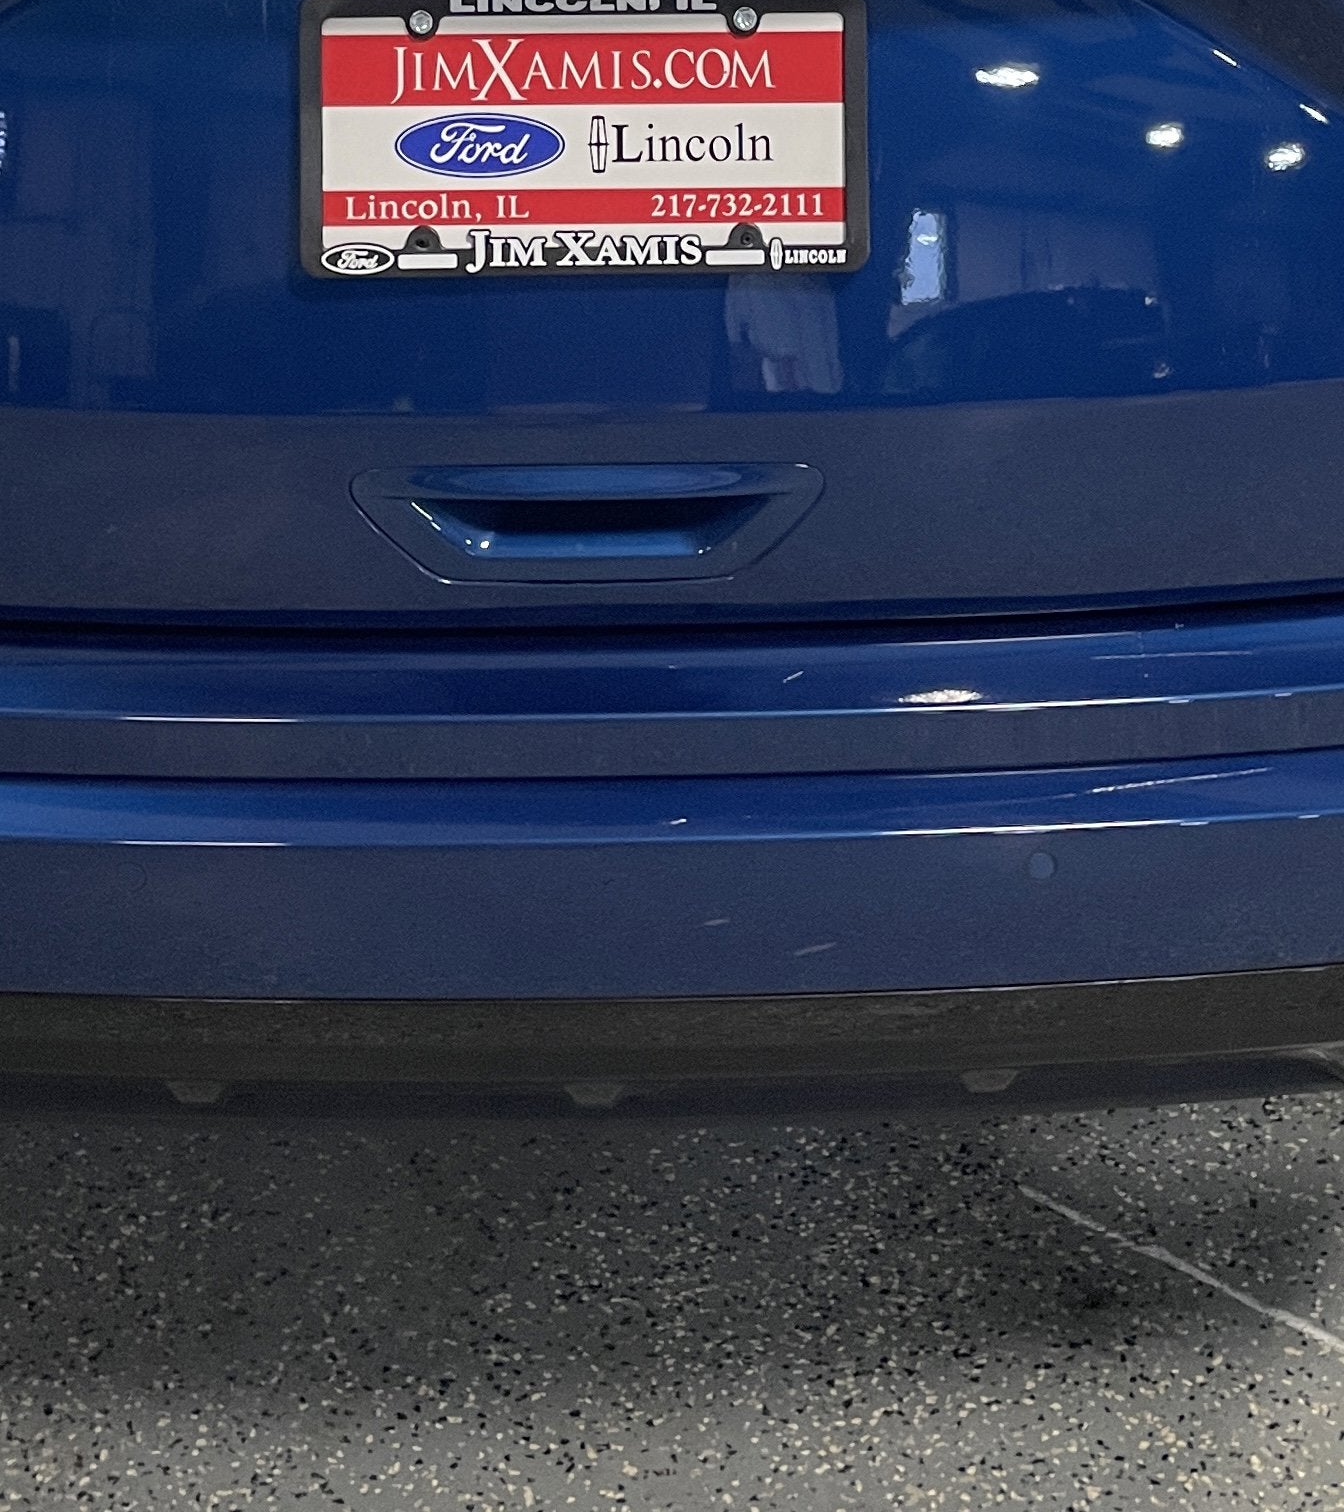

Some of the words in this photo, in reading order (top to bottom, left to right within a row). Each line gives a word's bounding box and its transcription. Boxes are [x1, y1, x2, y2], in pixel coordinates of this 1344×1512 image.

[390, 37, 777, 105] JIMXAMIS.COM
[429, 123, 531, 165] Ford
[611, 122, 774, 163] Lincoln
[345, 193, 482, 223] Lincoln,
[496, 195, 530, 219] IL
[651, 192, 824, 218] 217-732-2111
[465, 230, 548, 274] JIM
[555, 231, 702, 268] XAMIS
[784, 249, 847, 264] LINCOLN
